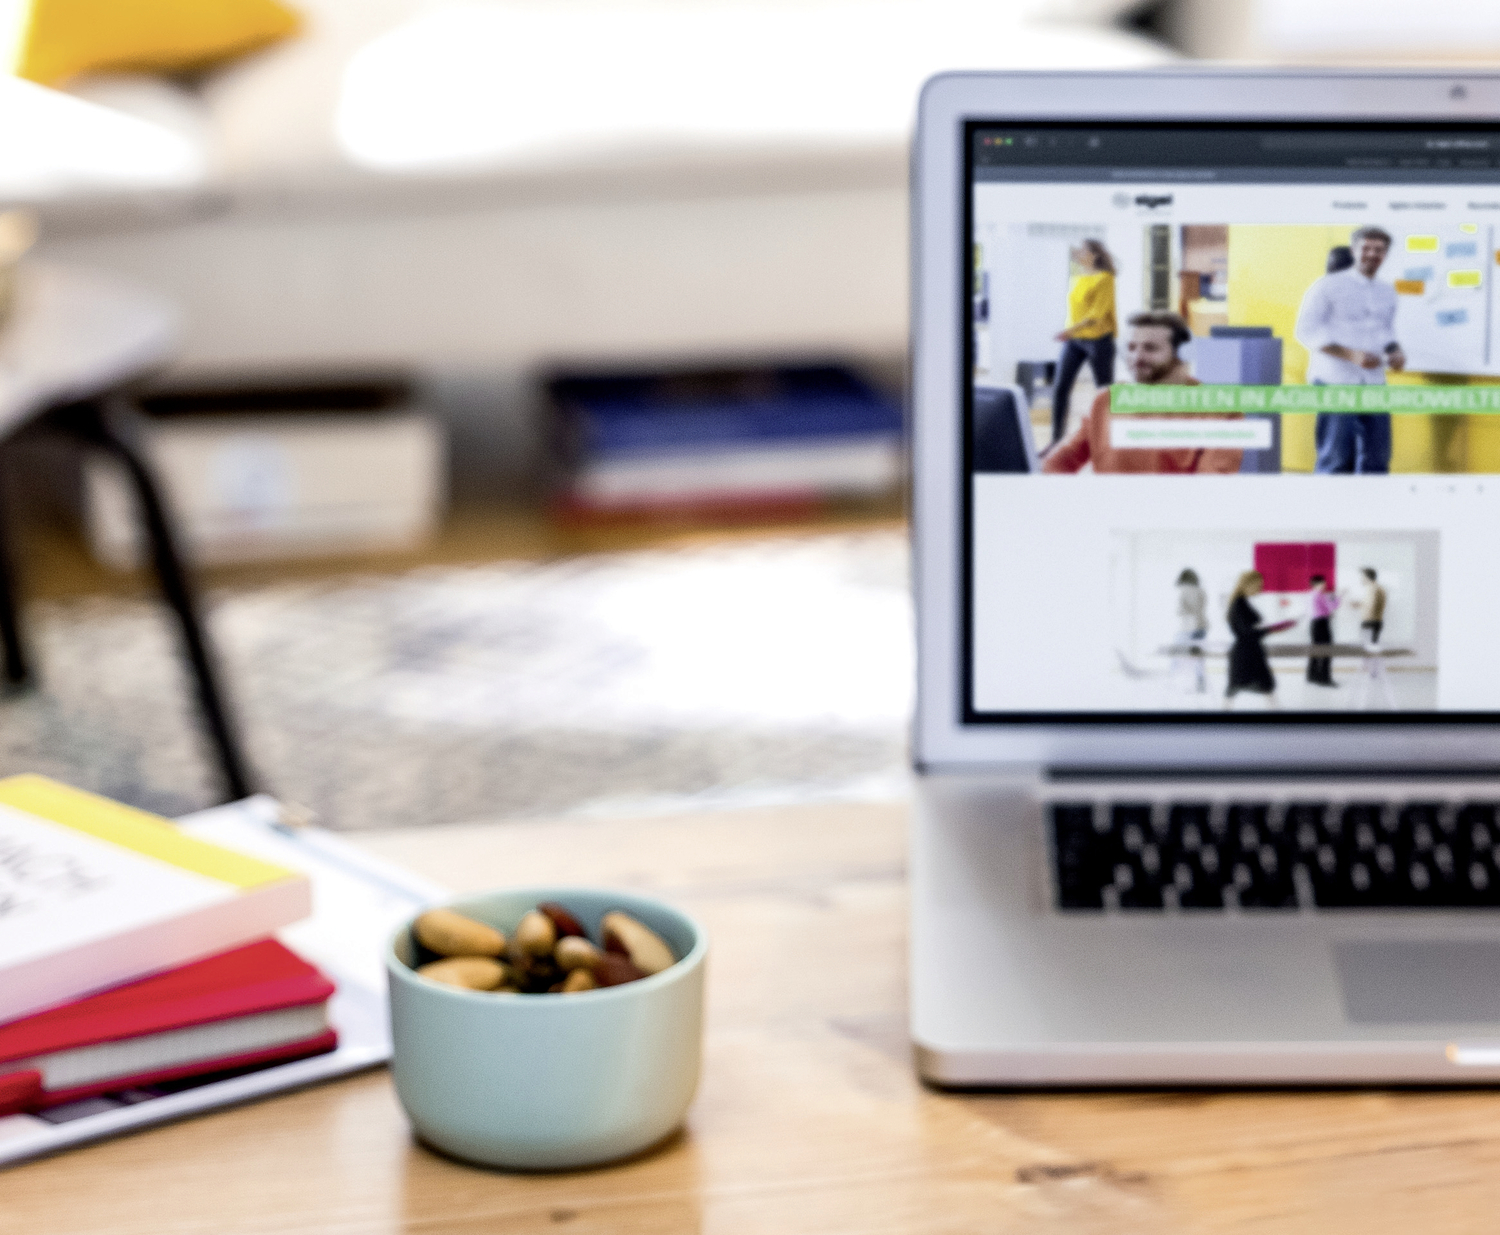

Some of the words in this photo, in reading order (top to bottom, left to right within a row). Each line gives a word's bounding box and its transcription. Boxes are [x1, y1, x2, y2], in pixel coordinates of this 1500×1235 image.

[1117, 388, 1237, 409] ARBEITEN
[1240, 388, 1265, 409] IN
[1269, 388, 1358, 410] AGILEN
